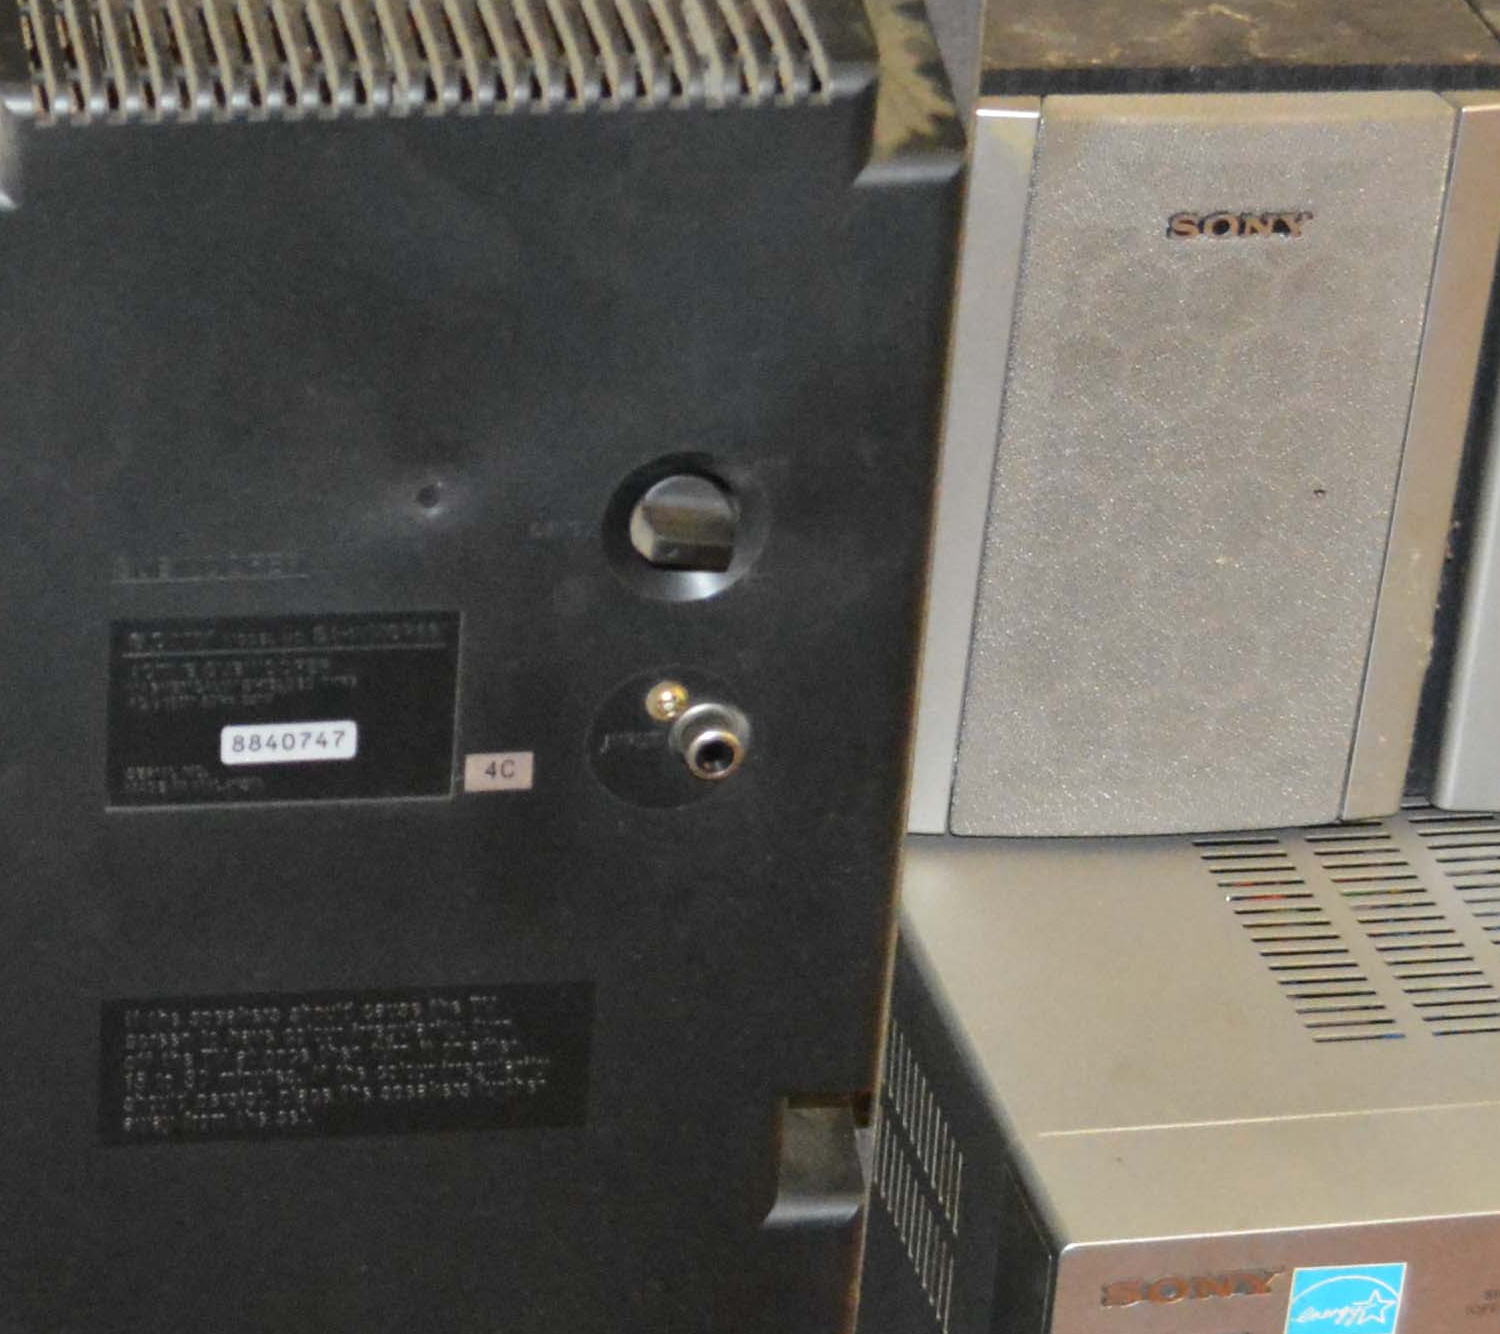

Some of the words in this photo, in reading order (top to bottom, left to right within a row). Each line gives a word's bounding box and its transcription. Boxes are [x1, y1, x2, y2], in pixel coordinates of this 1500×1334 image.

[1167, 210, 1313, 238] SONY
[231, 730, 346, 753] 8840747
[484, 758, 516, 779] 4C
[1100, 1267, 1285, 1308] SONY
